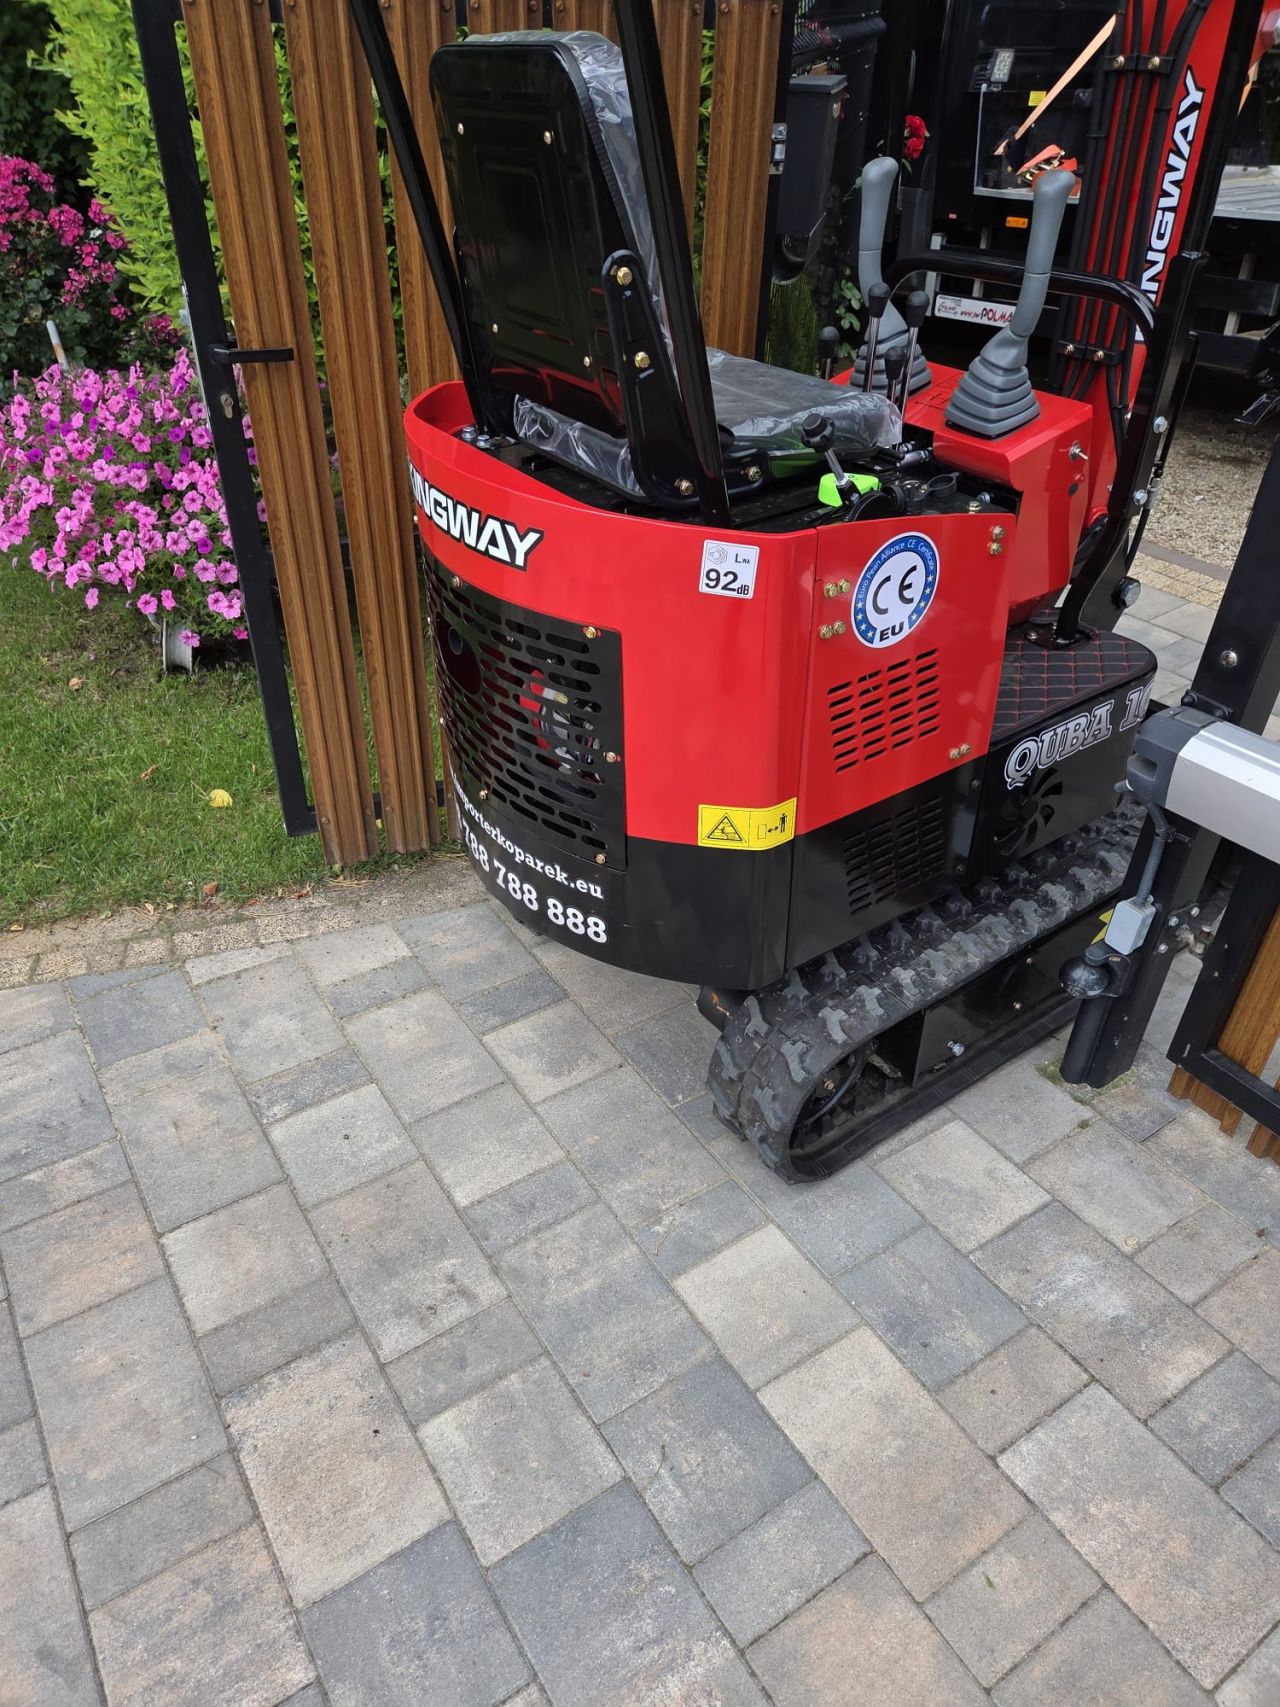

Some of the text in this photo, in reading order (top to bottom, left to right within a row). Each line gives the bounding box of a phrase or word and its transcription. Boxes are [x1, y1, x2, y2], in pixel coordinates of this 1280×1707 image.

[1134, 68, 1205, 341] NGWAY
[409, 462, 541, 567] INGWAY
[907, 539, 917, 548] CE
[872, 564, 917, 615] CE
[879, 621, 905, 642] EU
[1004, 700, 1115, 790] QUBA
[462, 816, 608, 944] 788 788 888
